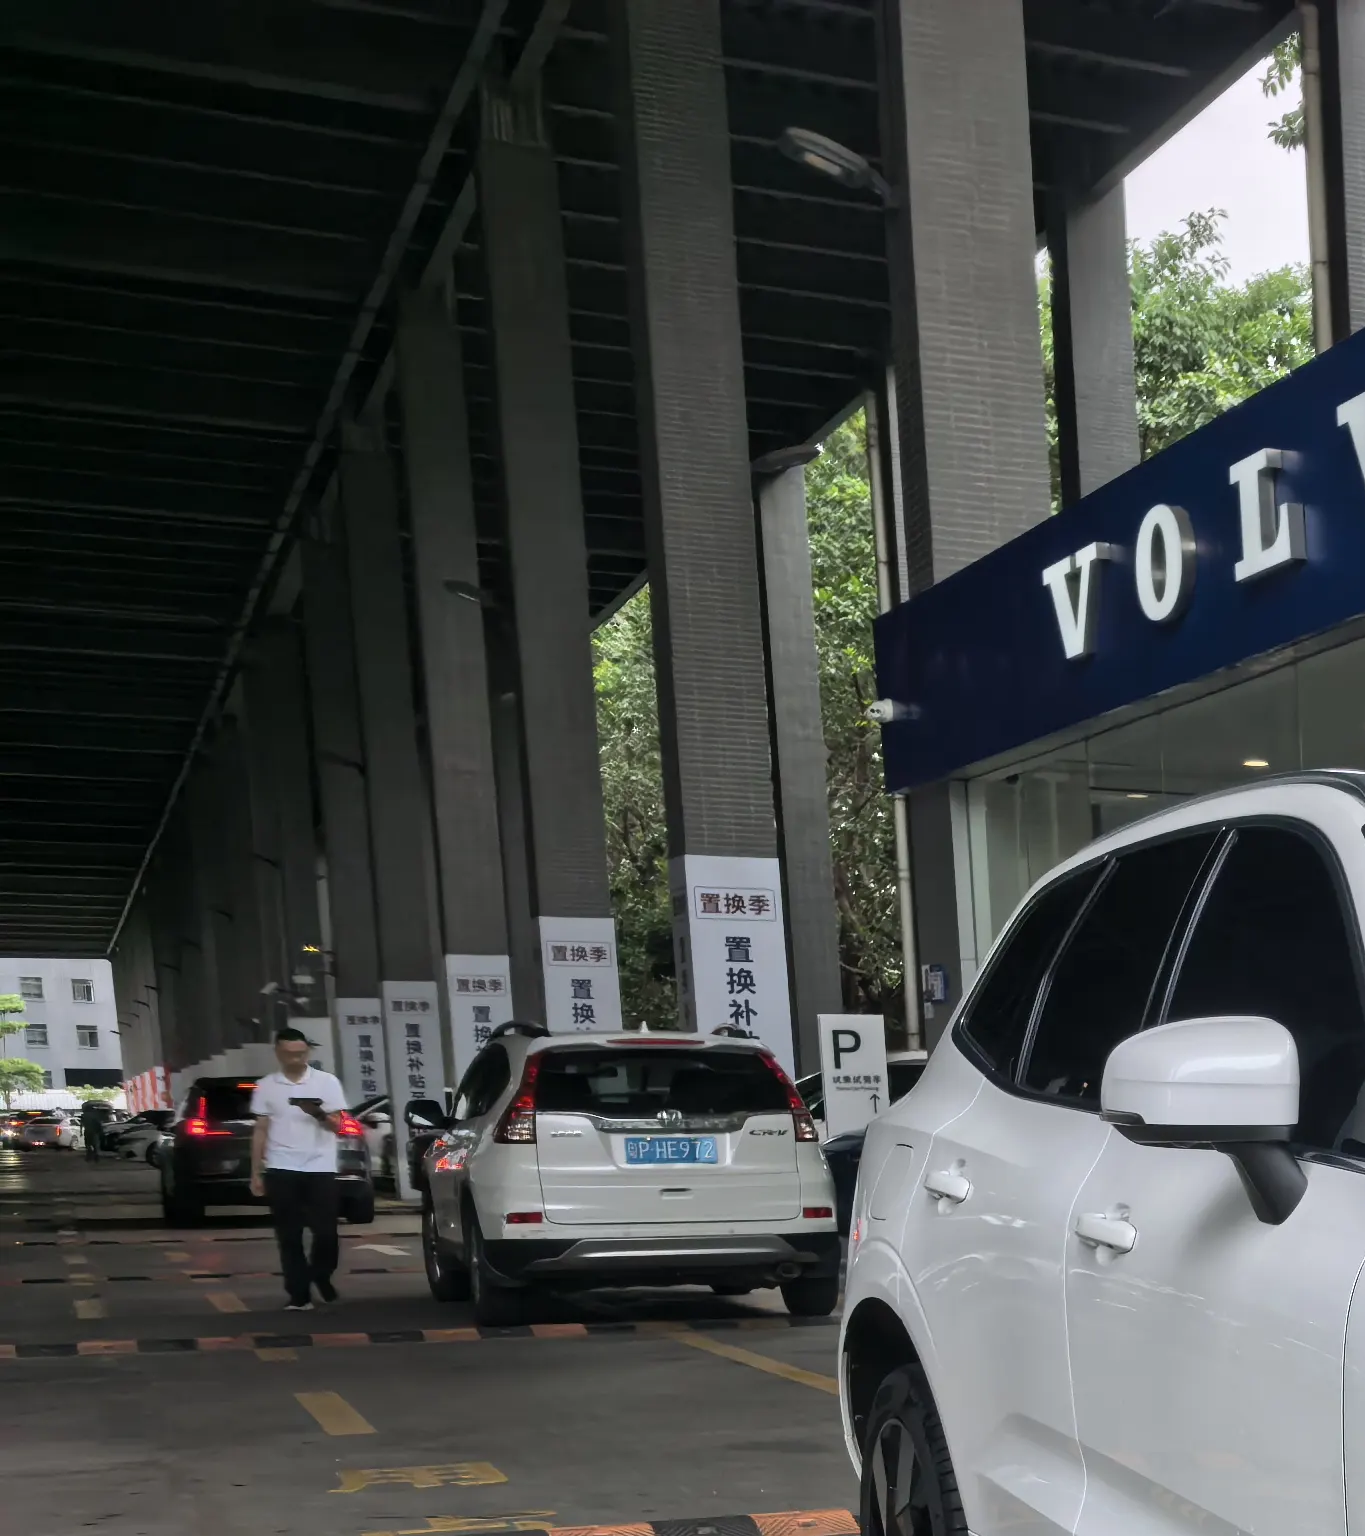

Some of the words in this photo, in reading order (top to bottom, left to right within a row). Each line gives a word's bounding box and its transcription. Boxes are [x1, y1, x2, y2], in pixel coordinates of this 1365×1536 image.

[700, 892, 771, 915] 置换季
[551, 945, 608, 962] 置换季
[570, 978, 596, 1031] 置换
[724, 936, 760, 1040] 置换补
[832, 1029, 861, 1070] P
